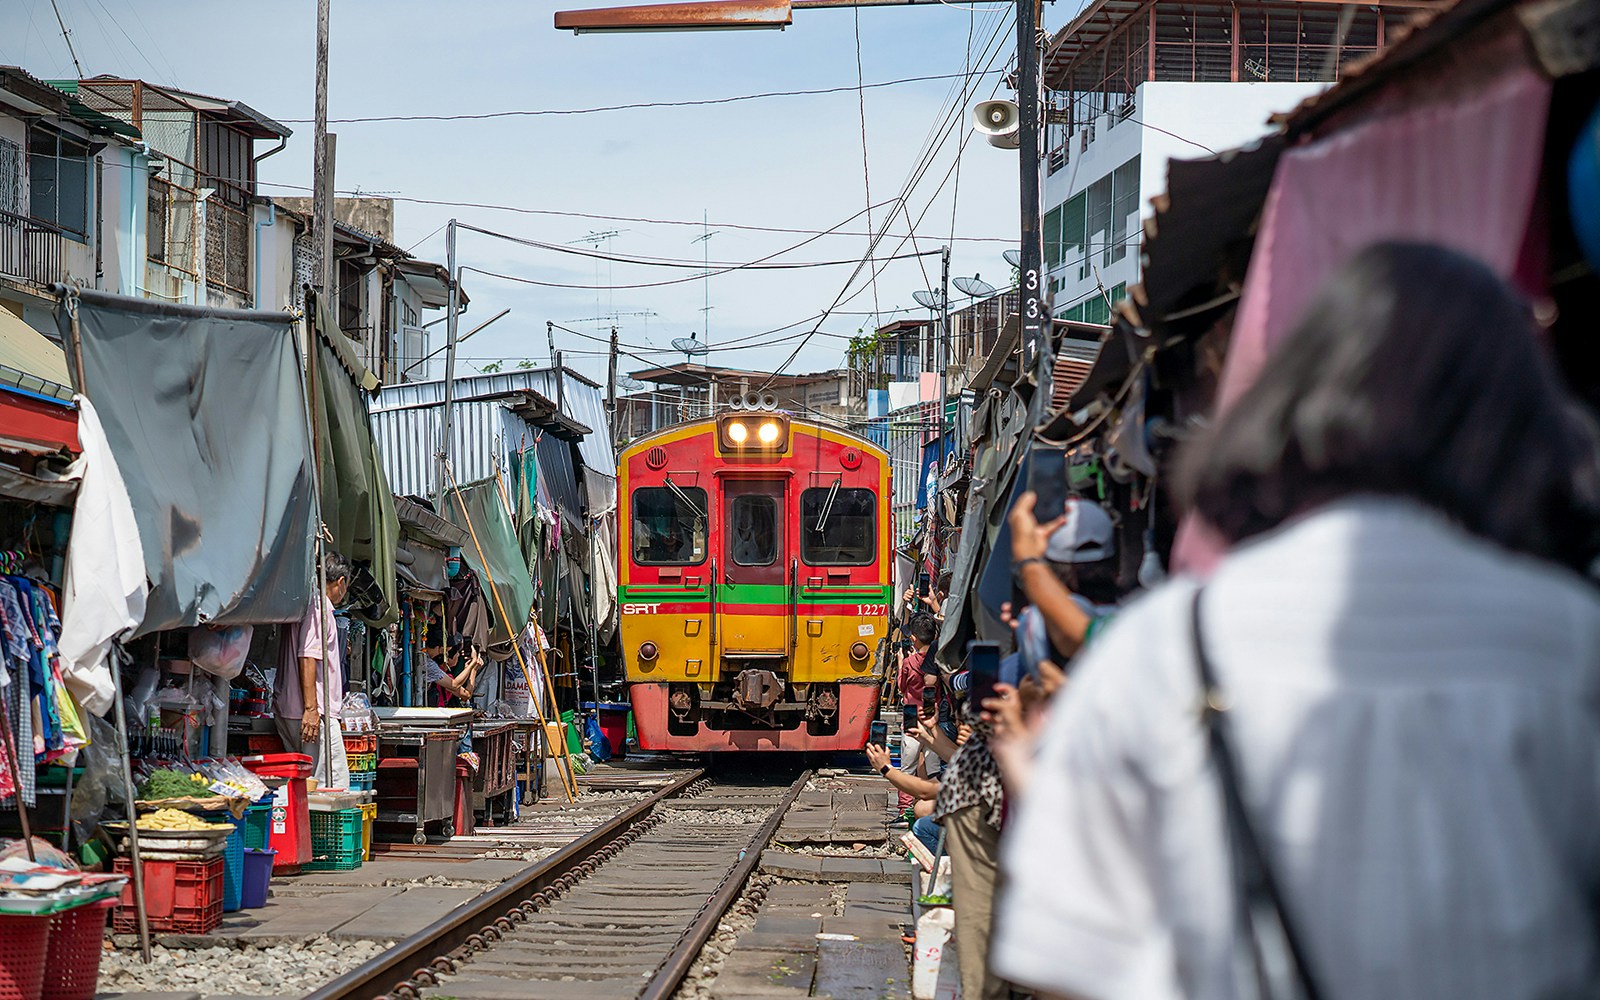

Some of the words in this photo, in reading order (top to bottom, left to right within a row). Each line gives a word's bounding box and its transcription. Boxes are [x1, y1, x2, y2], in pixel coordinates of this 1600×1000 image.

[623, 603, 661, 615] SRT
[857, 604, 886, 616] 1227
[505, 681, 529, 692] DAME
